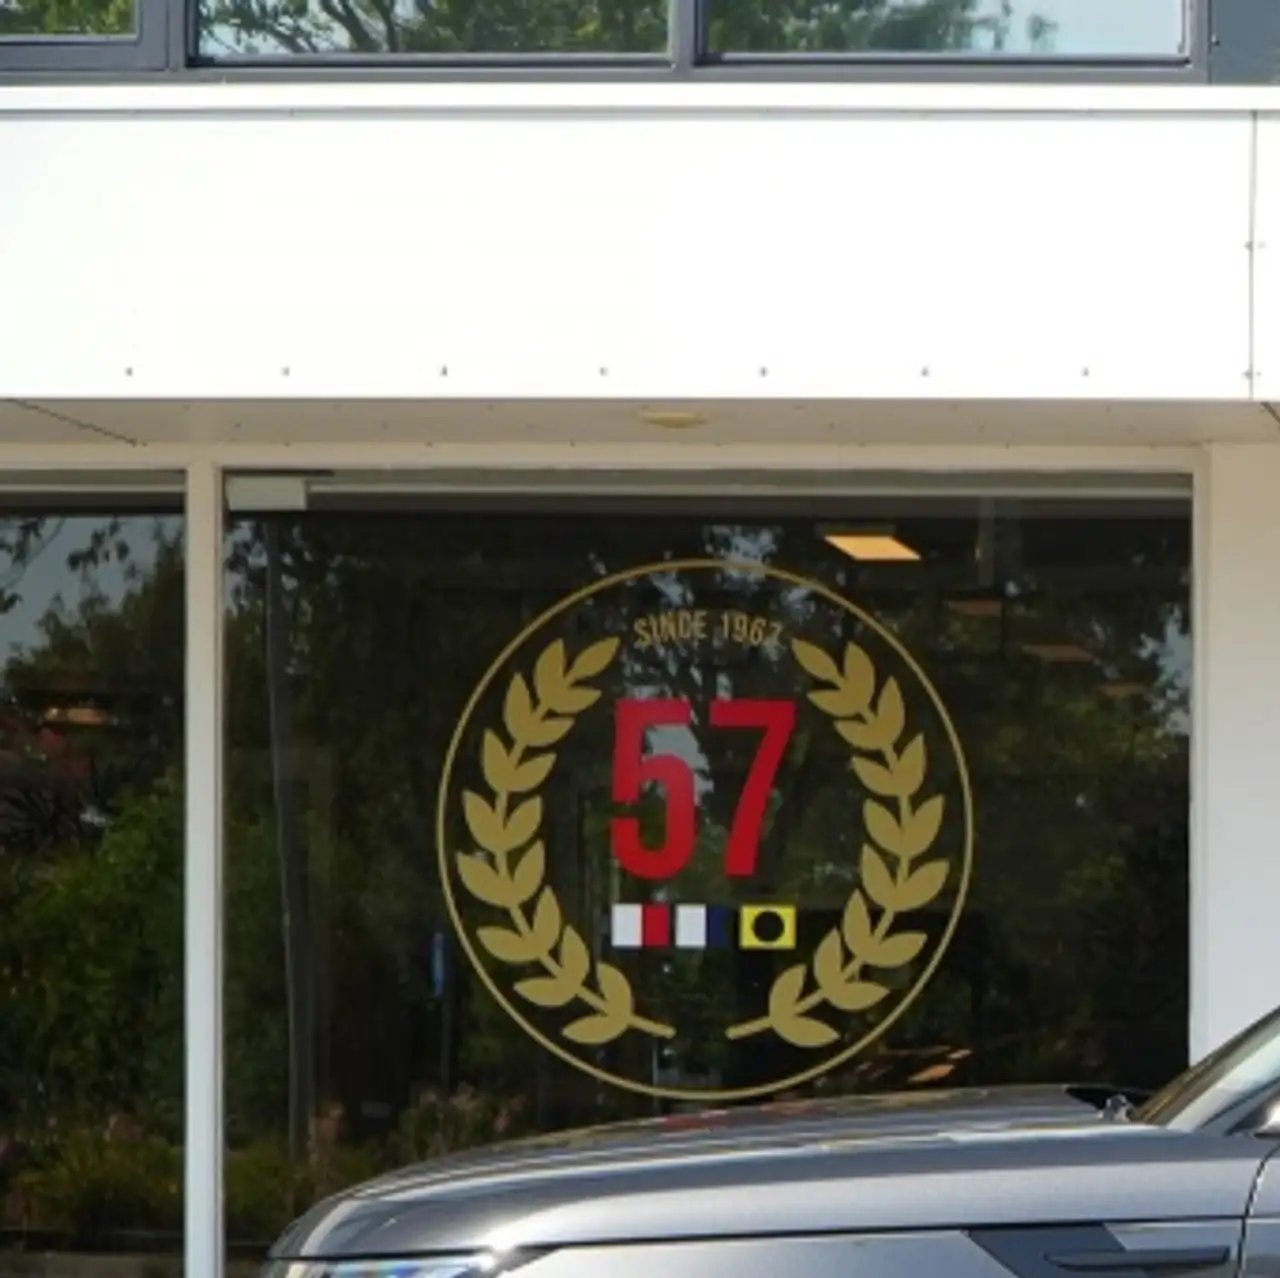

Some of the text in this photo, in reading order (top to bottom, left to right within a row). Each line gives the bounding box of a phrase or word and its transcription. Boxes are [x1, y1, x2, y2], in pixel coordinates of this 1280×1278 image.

[633, 609, 784, 649] SINCE 1967
[610, 697, 797, 880] 57
